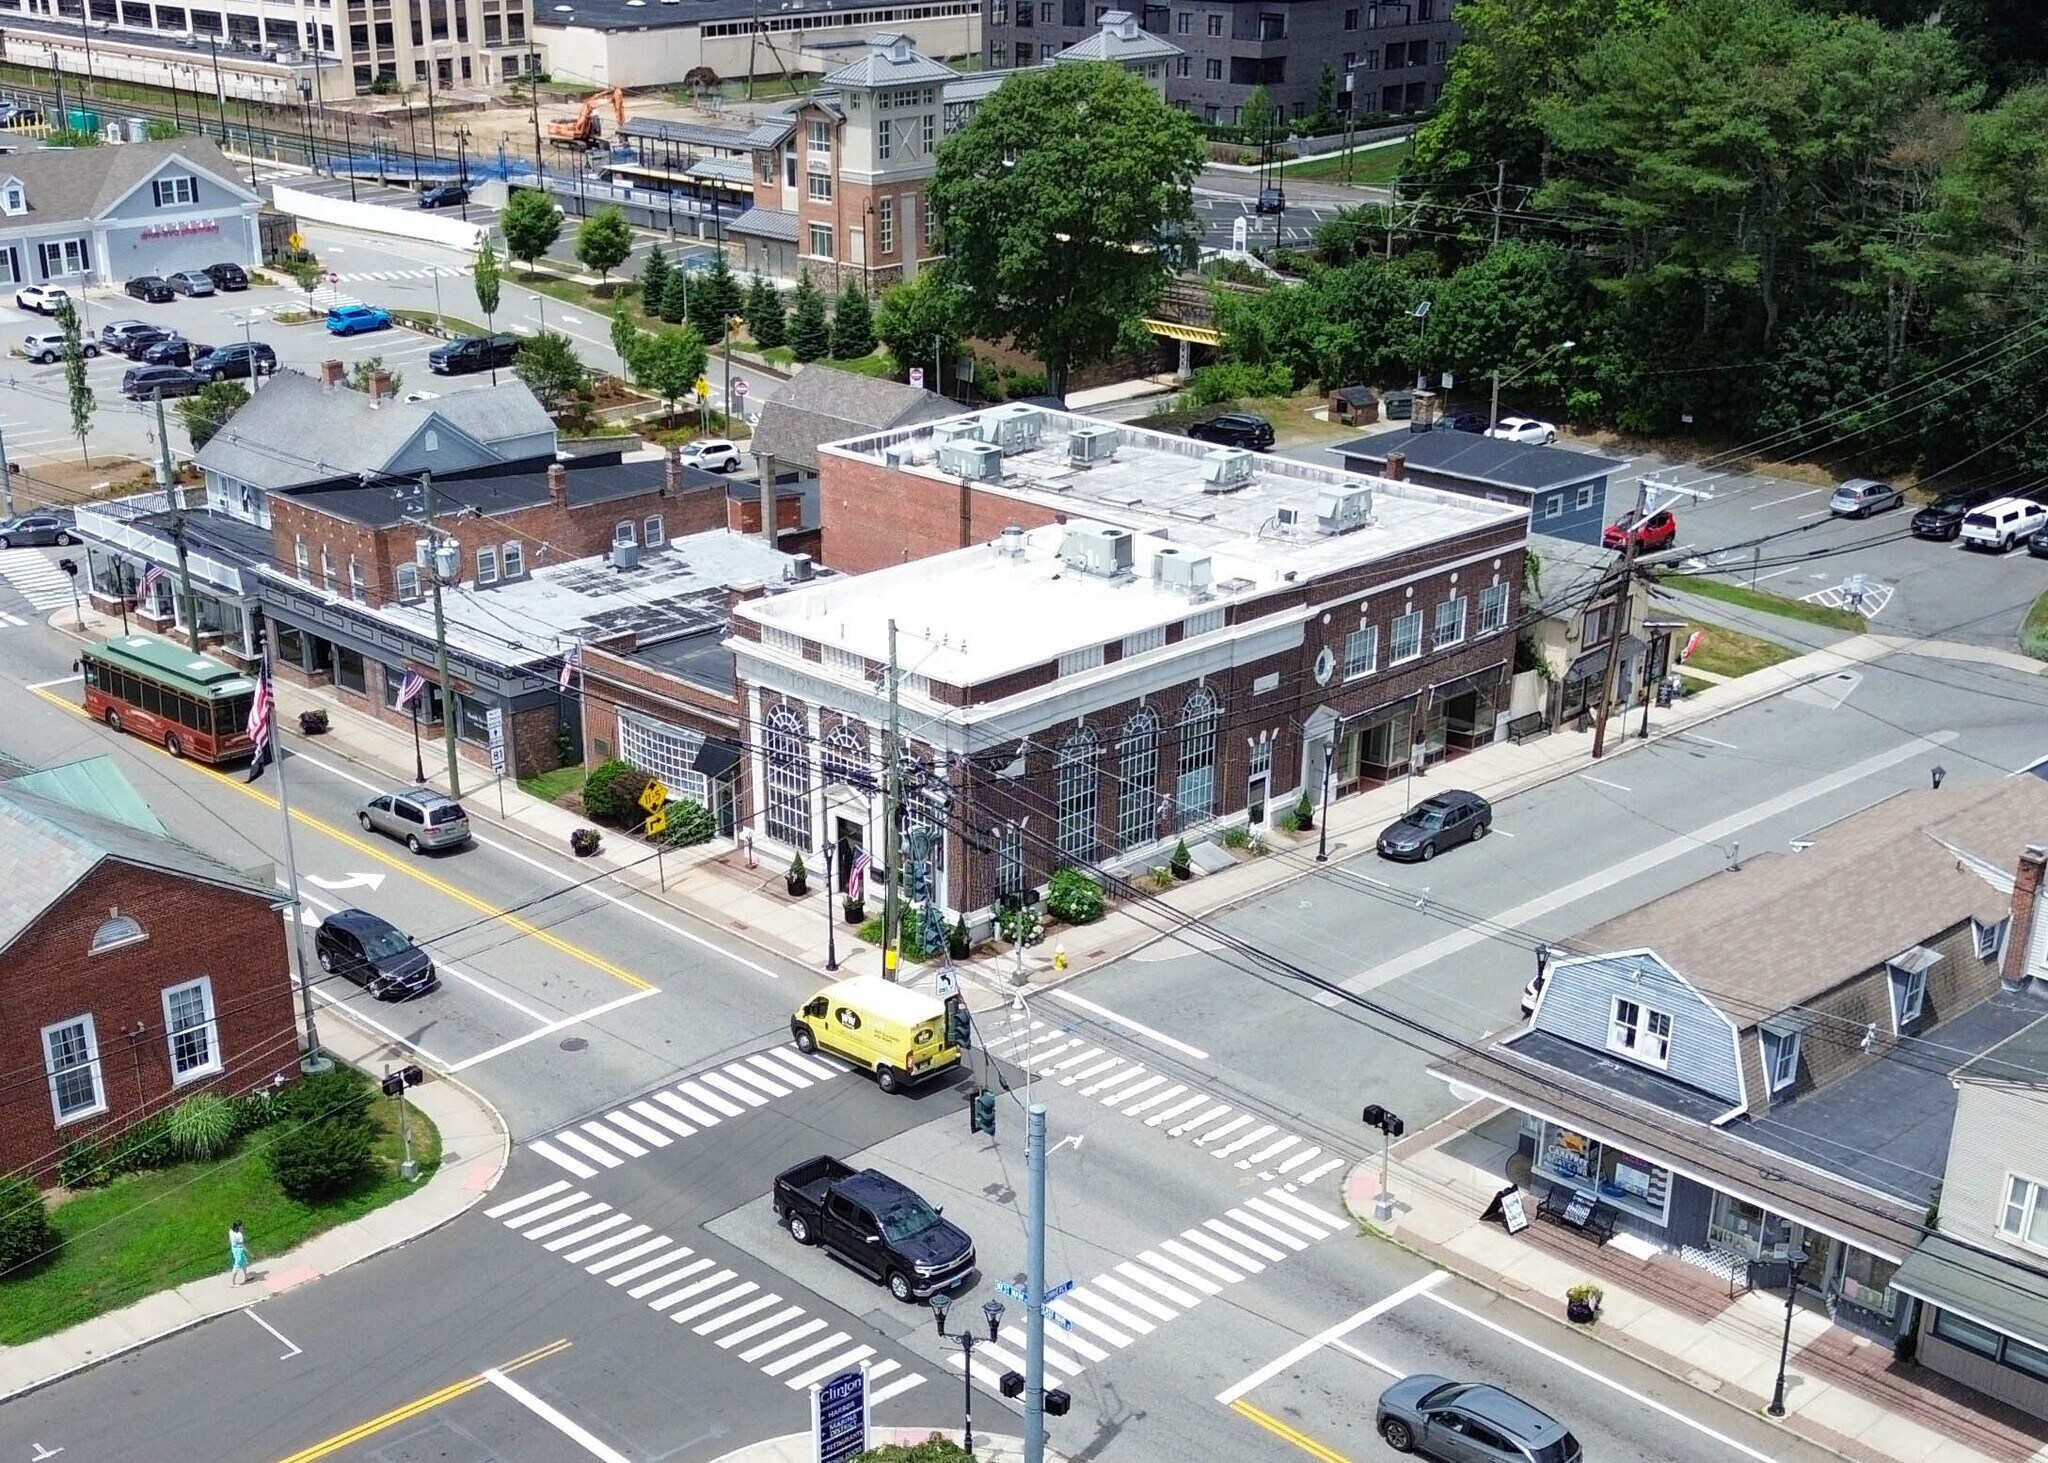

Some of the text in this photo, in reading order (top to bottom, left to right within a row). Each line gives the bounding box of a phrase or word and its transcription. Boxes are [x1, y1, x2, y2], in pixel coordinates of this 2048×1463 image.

[763, 663, 816, 691] CLINTON
[493, 748, 504, 761] 81
[1545, 1152, 1567, 1169] BOAT
[1567, 1162, 1588, 1177] CLUB
[1548, 1144, 1589, 1168] CAREFREE
[820, 1378, 862, 1403] Clinton
[828, 1401, 855, 1418] HARBOR
[829, 1413, 858, 1430] MARINA
[829, 1420, 857, 1438] DISTRICT
[826, 1430, 863, 1451] RESTAURANTS
